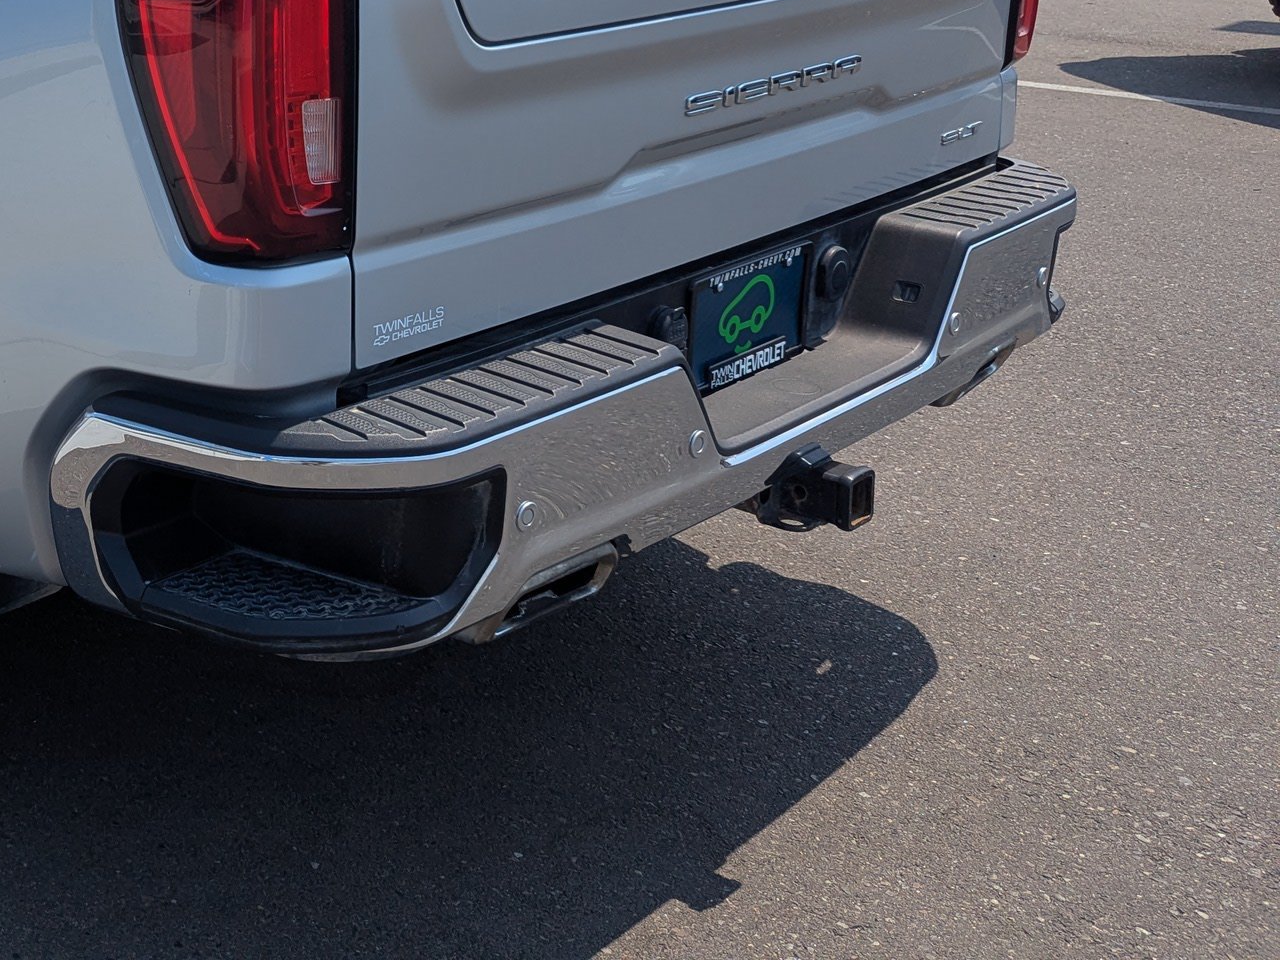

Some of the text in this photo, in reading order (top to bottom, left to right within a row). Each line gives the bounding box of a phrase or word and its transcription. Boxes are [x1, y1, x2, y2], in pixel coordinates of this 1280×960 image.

[685, 54, 862, 116] SIERRA
[941, 120, 983, 145] SLT
[373, 306, 444, 336] TWINFALLS
[392, 319, 444, 341] CHEVROLET
[711, 362, 734, 382] TWIN
[733, 341, 786, 379] CHEVROLET
[710, 372, 734, 389] FALLS
